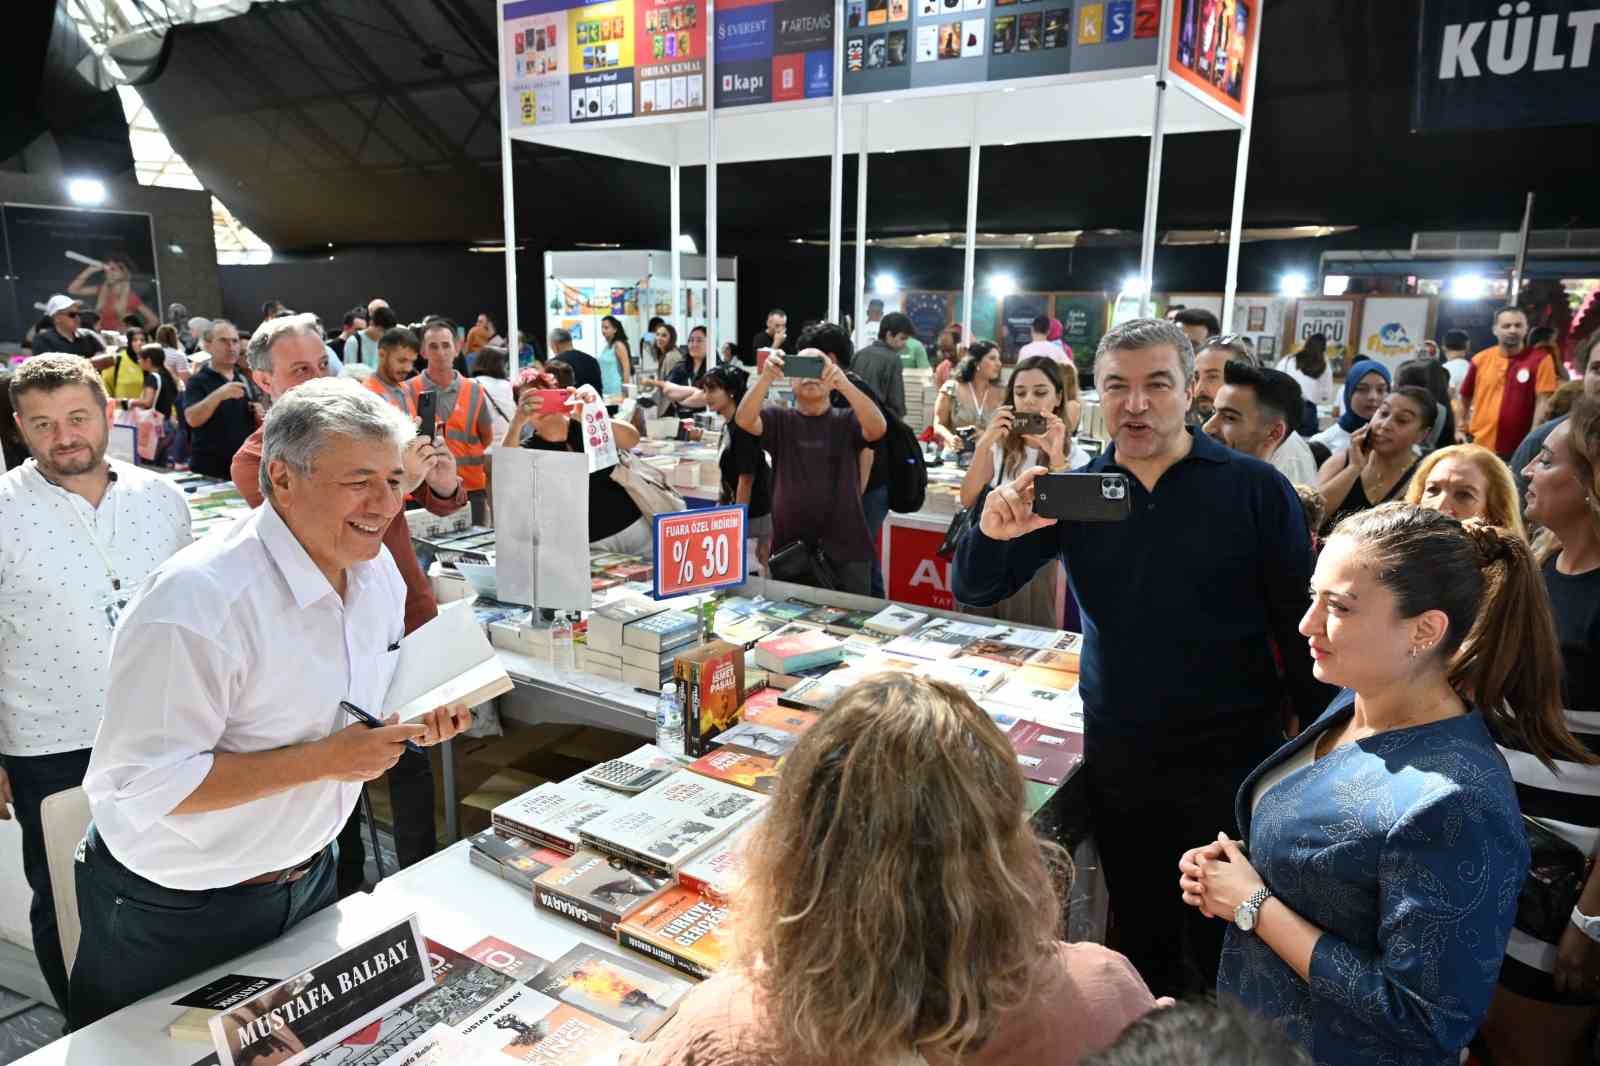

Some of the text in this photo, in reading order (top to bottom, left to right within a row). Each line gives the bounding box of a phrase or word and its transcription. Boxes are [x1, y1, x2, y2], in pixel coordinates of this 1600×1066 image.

[1111, 13, 1125, 35] S
[1438, 1, 1600, 80] KÜLT
[640, 60, 702, 77] ORHAN KEMAL
[734, 74, 764, 93] kapı
[1302, 319, 1344, 342] GÜCÜ
[665, 523, 689, 537] FUARA
[690, 519, 709, 534] ÖZEL
[701, 533, 729, 578] 30
[540, 891, 588, 922] SAKARYA
[236, 939, 410, 1049] MUSTAFA BALBAY
